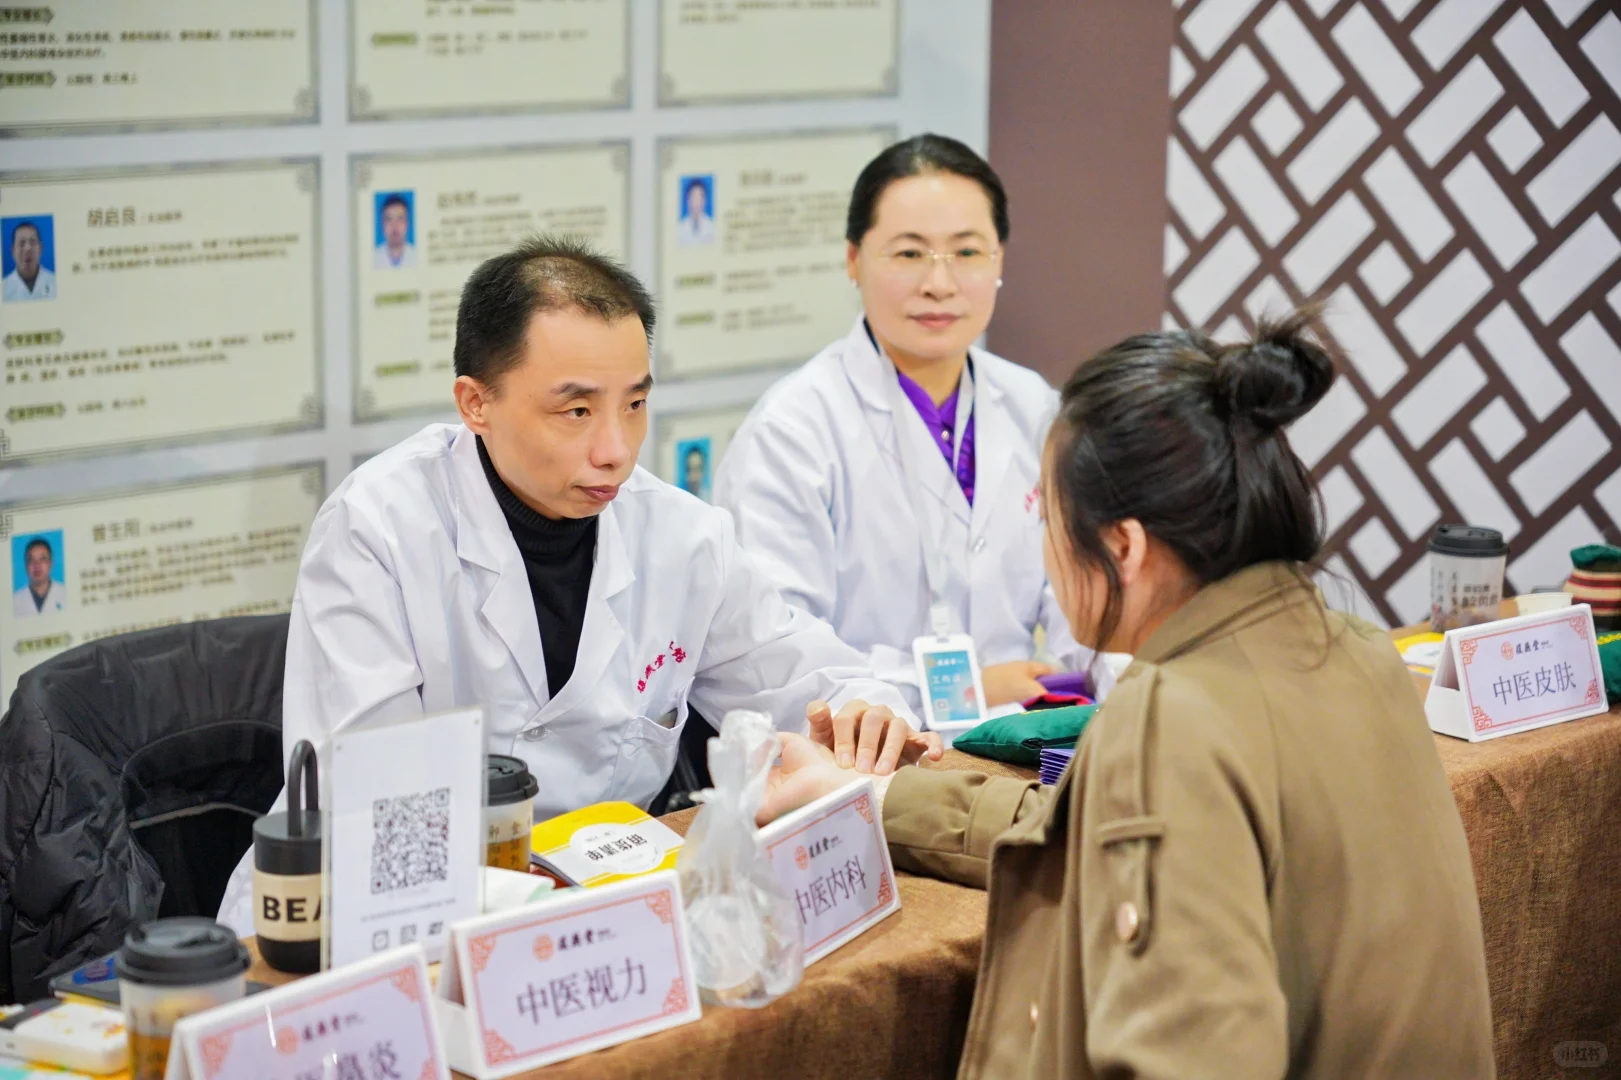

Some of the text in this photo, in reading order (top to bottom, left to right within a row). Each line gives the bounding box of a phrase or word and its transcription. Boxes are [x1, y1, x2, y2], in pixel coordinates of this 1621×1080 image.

[1493, 661, 1576, 705] 中医皮肤
[795, 855, 868, 925] 中医内科
[517, 957, 647, 1026] 中医视力
